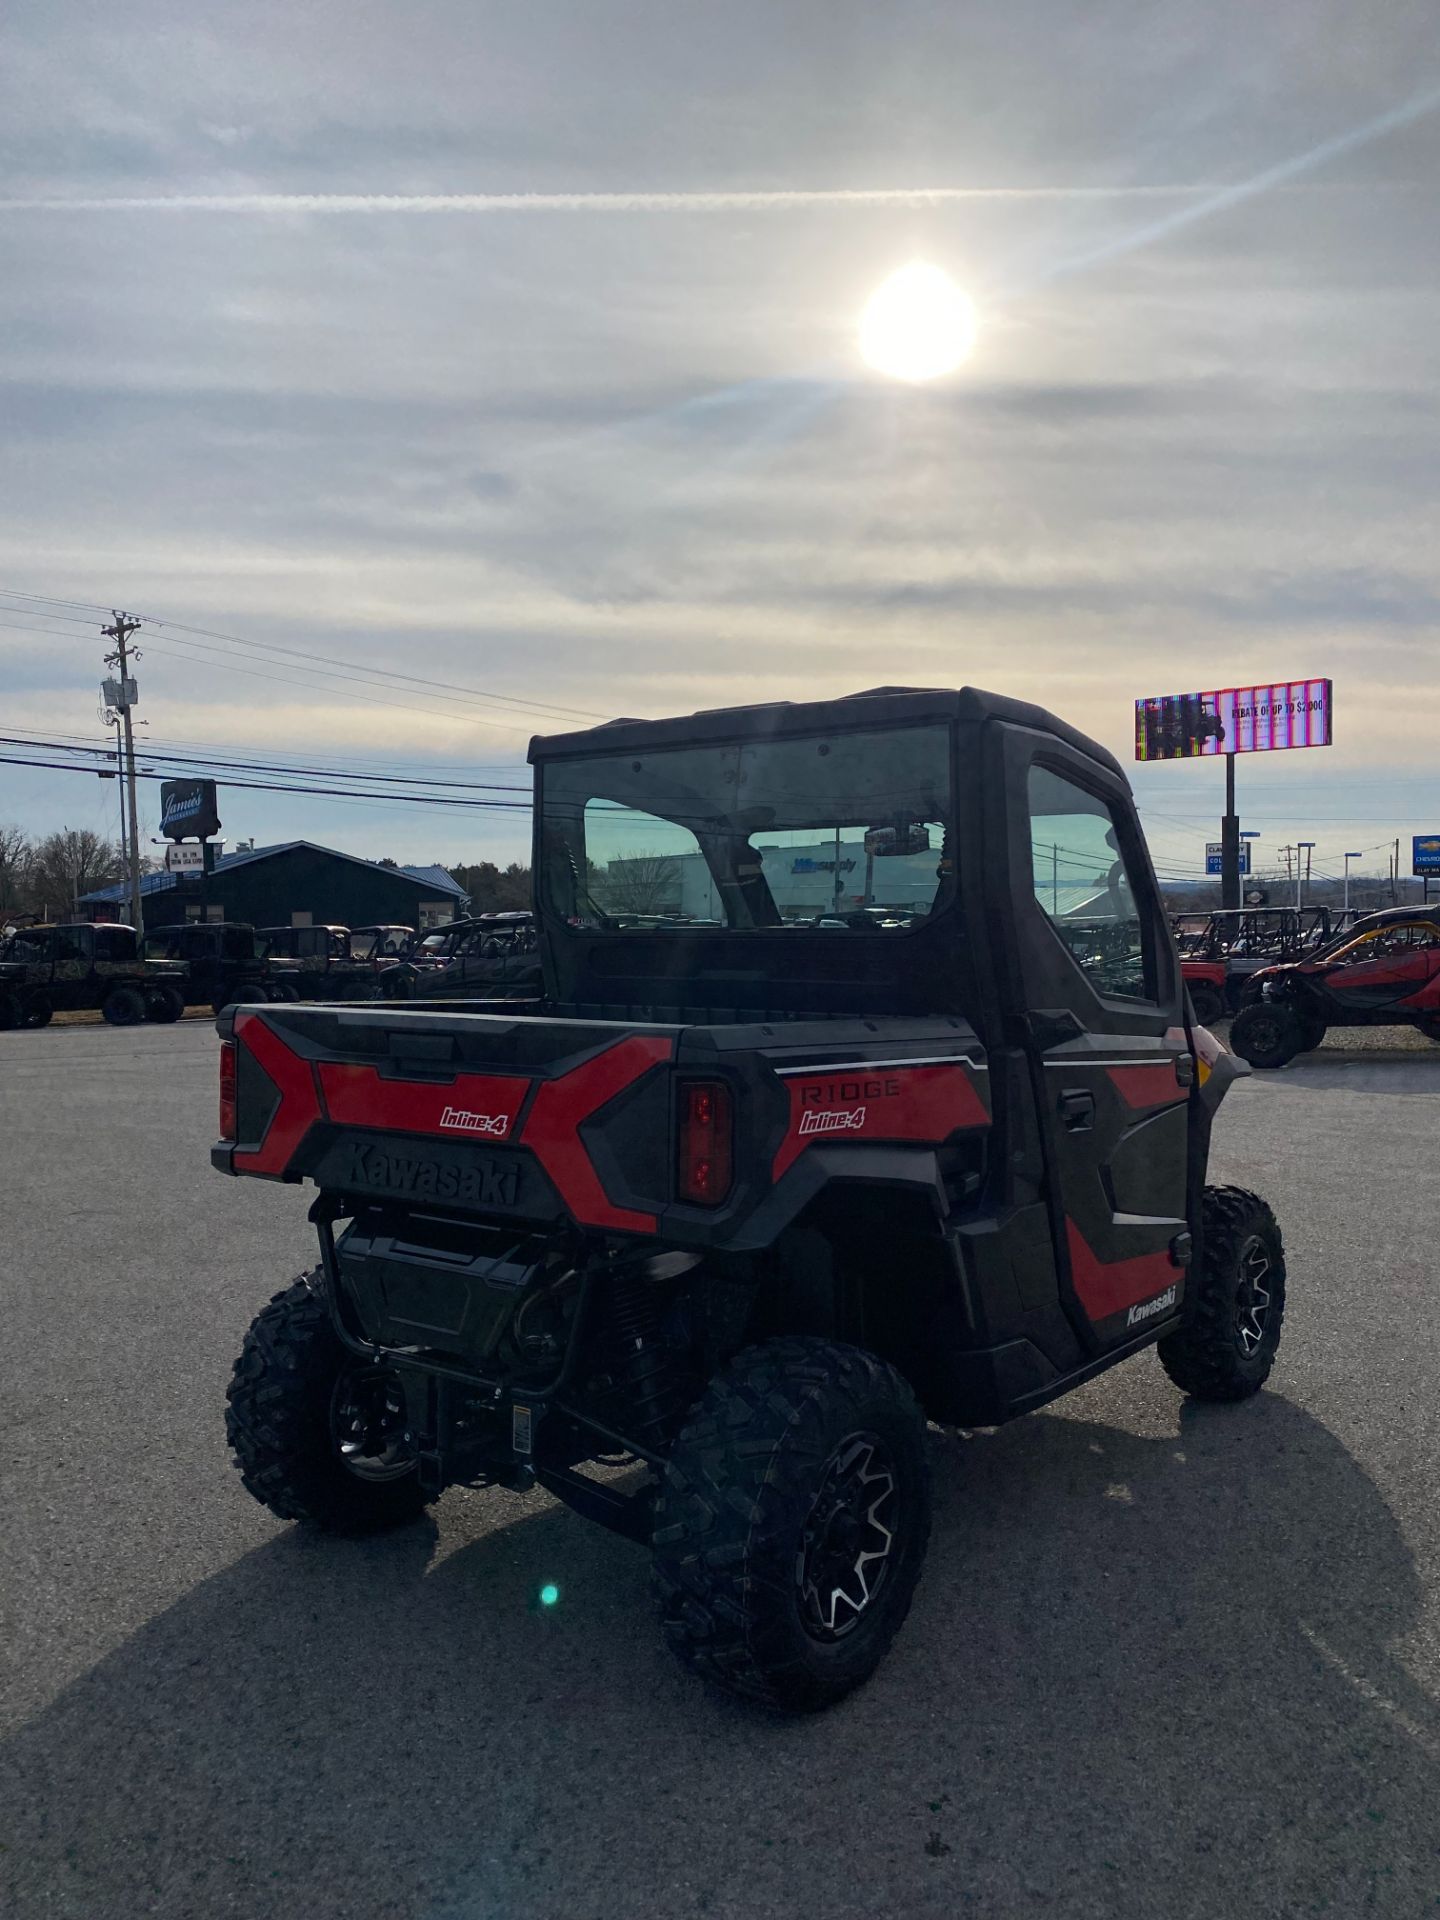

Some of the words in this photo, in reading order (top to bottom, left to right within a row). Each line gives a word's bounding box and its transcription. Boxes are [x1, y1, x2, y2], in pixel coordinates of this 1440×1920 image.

[1272, 704, 1283, 715] UP
[1285, 703, 1295, 714] TO
[801, 1079, 900, 1106] RIDGE
[439, 1107, 508, 1135] Inline-4
[799, 1106, 866, 1135] Inline-4
[350, 1143, 521, 1204] Kawasaki
[1126, 1284, 1177, 1327] Kawasaki
